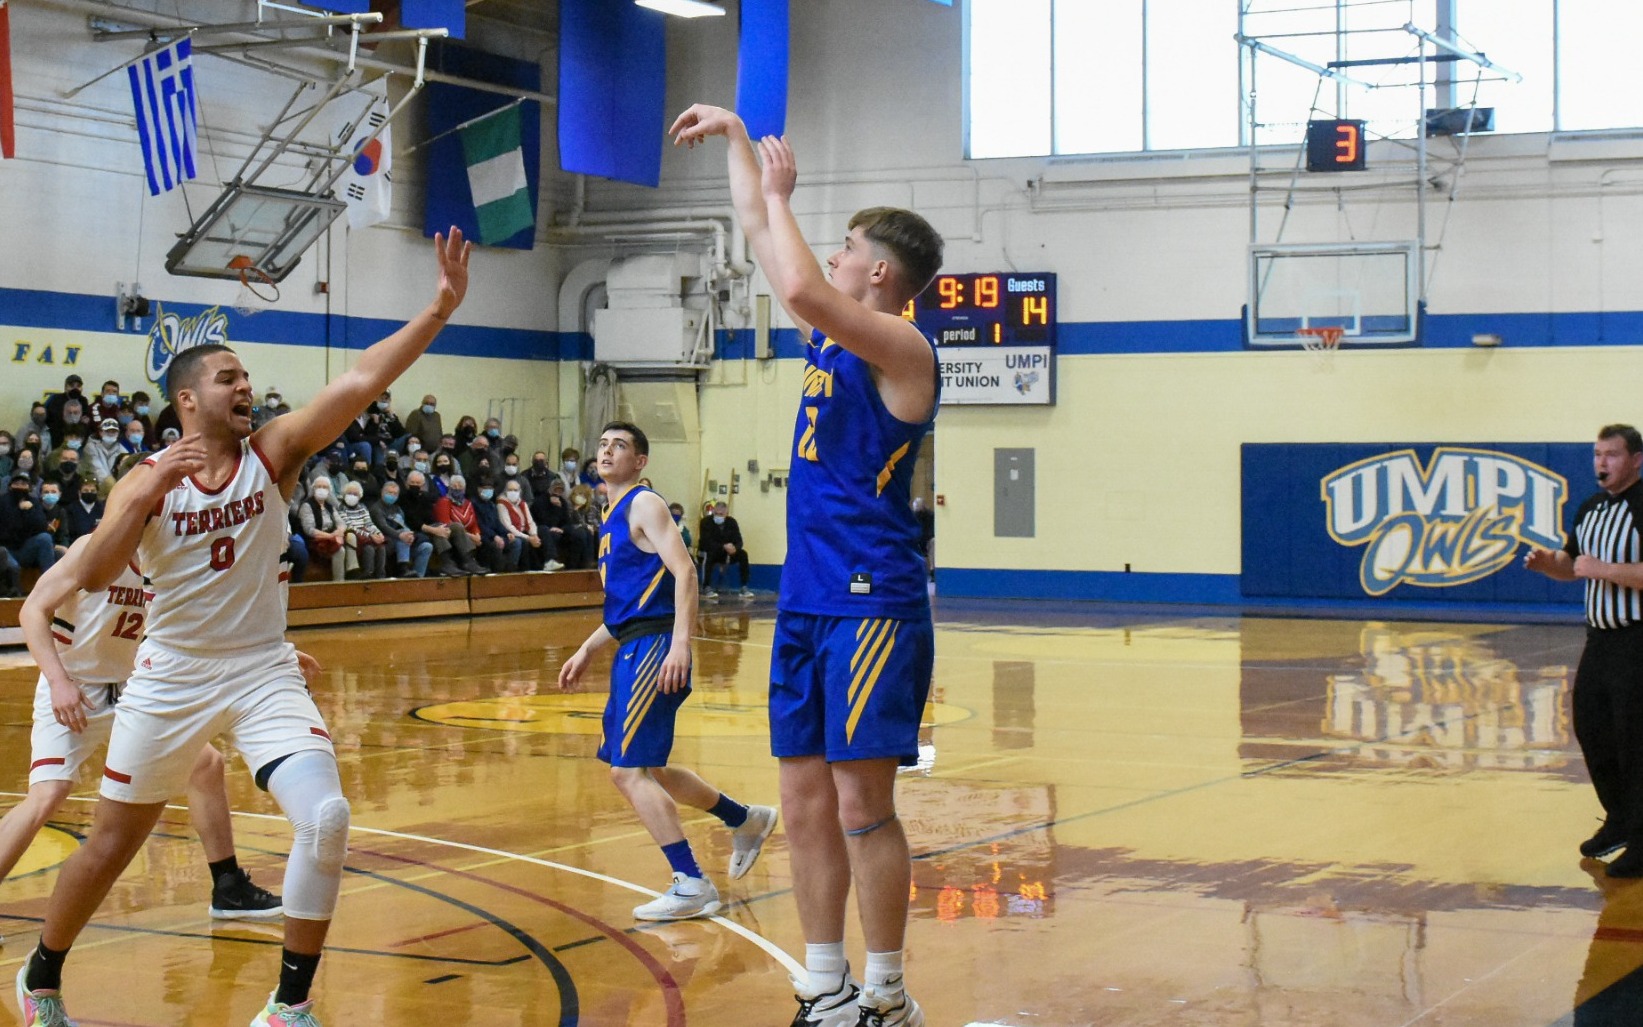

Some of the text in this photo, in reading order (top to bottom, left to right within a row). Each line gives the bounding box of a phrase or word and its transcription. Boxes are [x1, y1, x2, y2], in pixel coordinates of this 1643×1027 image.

[1336, 125, 1357, 162] 3
[939, 277, 998, 308] 9:19
[1008, 278, 1045, 292] Guests
[1023, 296, 1047, 325] 14
[943, 323, 1001, 343] period 1
[13, 342, 81, 365] FAN
[940, 362, 983, 374] ERSITY
[1005, 354, 1048, 369] UMPI
[956, 376, 999, 387] UNION
[1325, 452, 1562, 544] UMPI
[172, 490, 265, 536] TERRIERS
[209, 536, 236, 572] 0
[1360, 505, 1519, 596] Owls
[111, 611, 144, 641] 12
